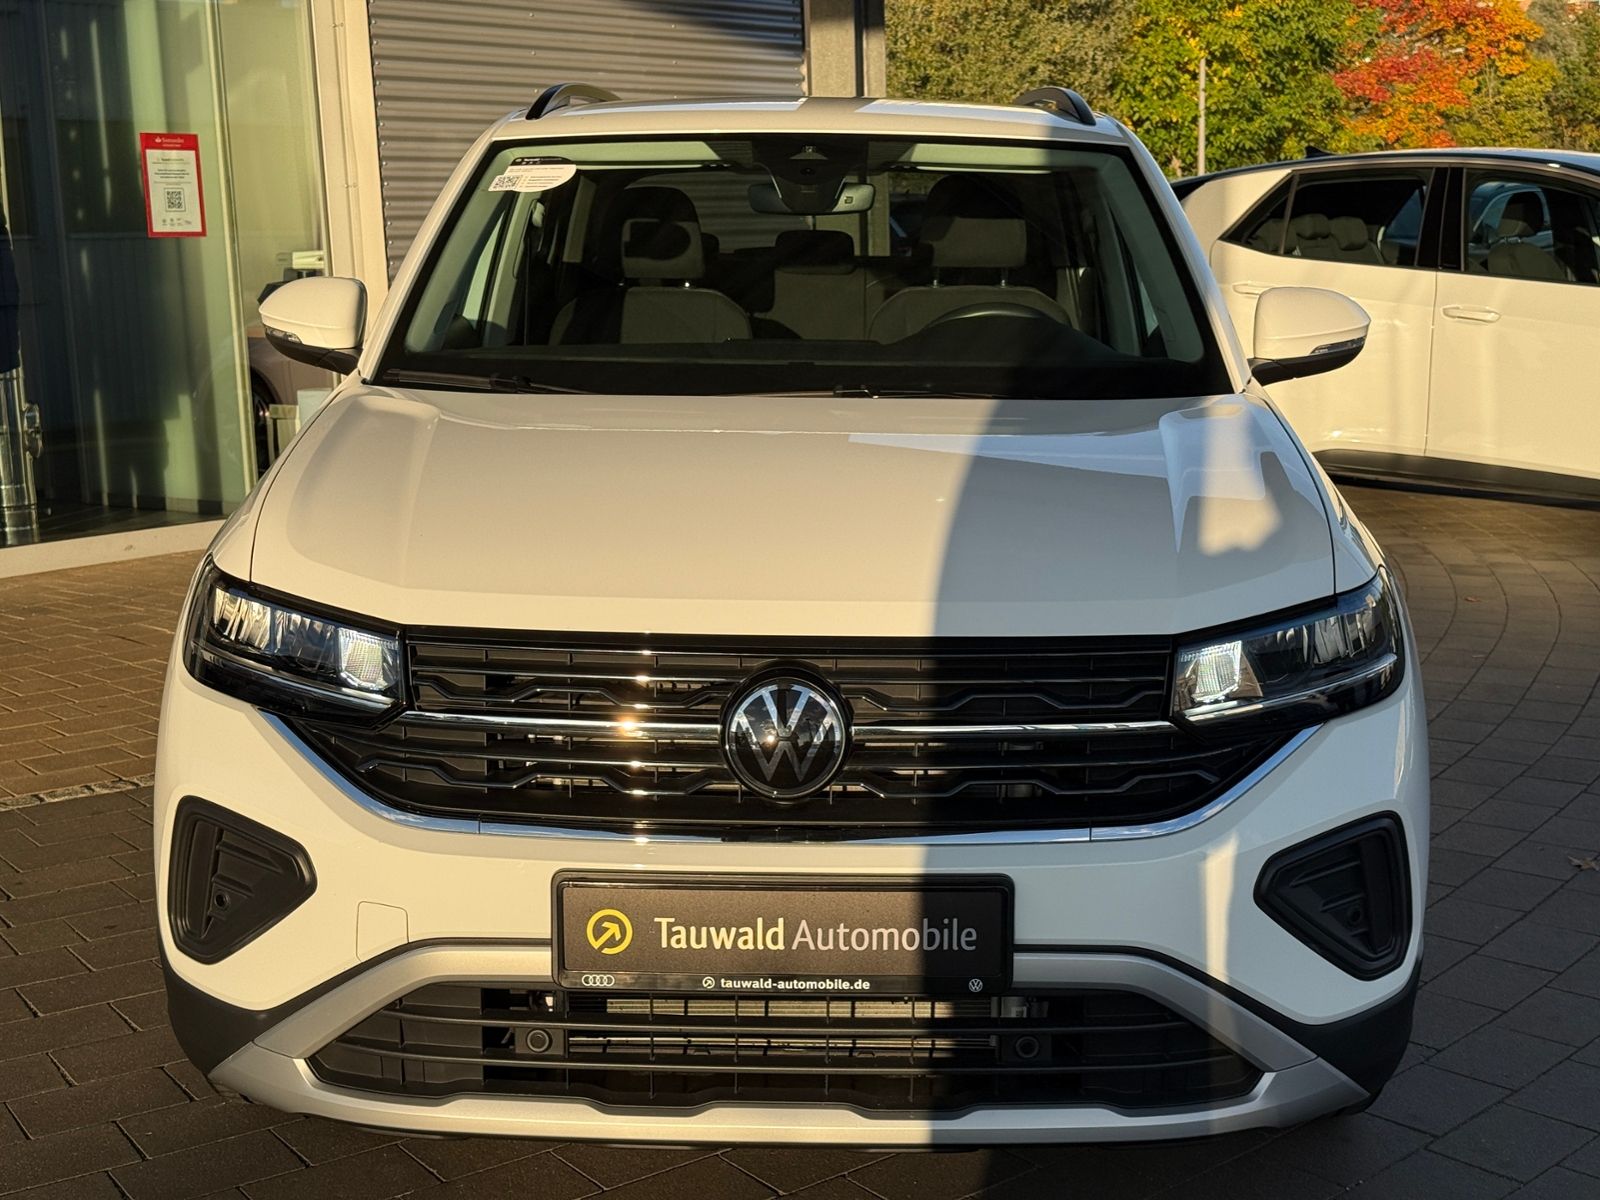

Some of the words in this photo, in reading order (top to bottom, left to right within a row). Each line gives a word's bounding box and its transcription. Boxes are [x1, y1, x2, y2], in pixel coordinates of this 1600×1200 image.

[653, 917, 785, 950] Tauwald
[791, 917, 977, 951] Automobile
[720, 978, 871, 990] tauwald-automobile.de
